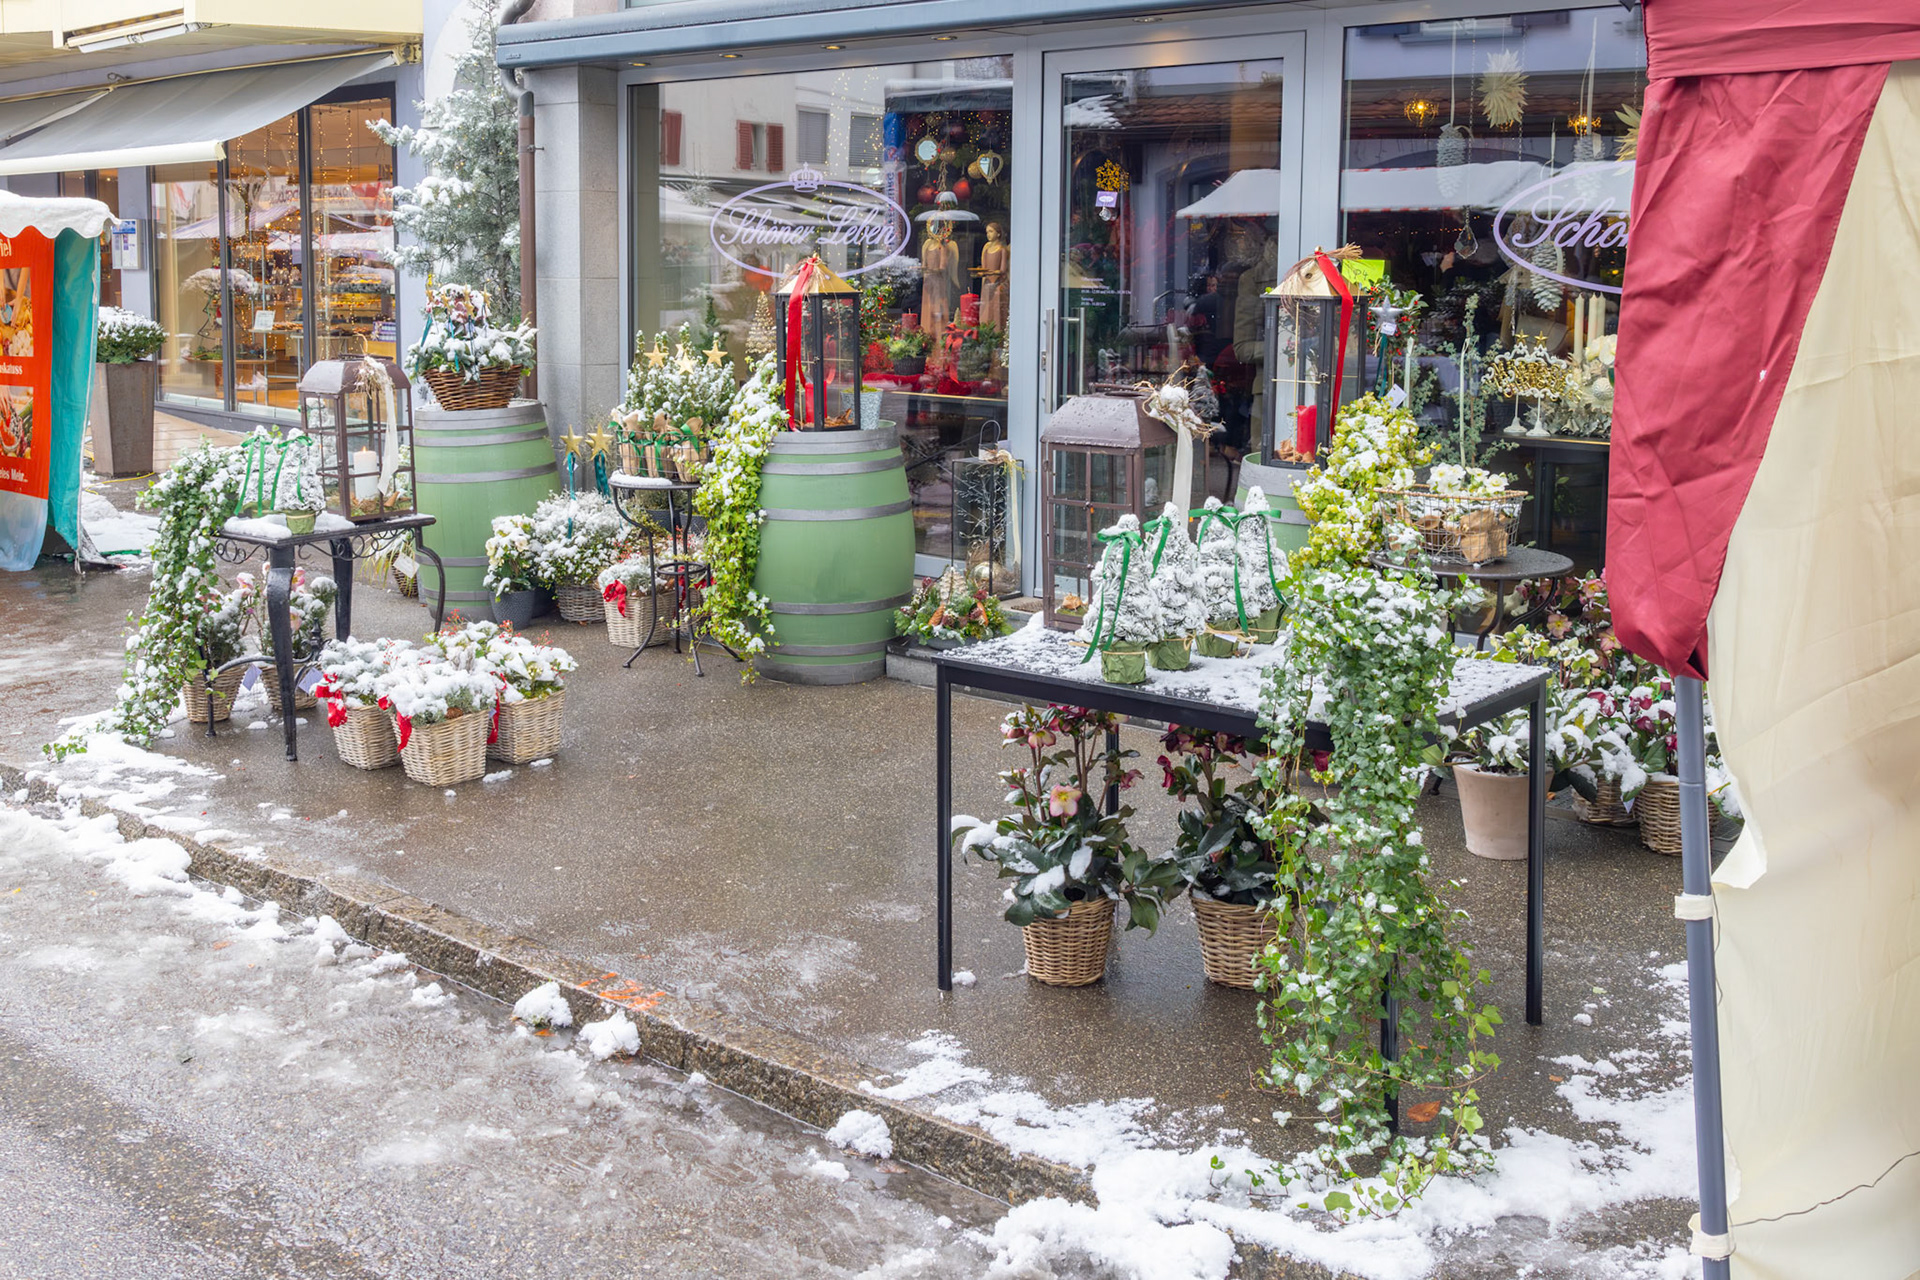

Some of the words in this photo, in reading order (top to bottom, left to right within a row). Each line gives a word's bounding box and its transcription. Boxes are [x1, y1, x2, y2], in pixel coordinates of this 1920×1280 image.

[720, 207, 815, 245] Schöner
[818, 205, 897, 245] Leben
[1512, 195, 1630, 248] Schö
